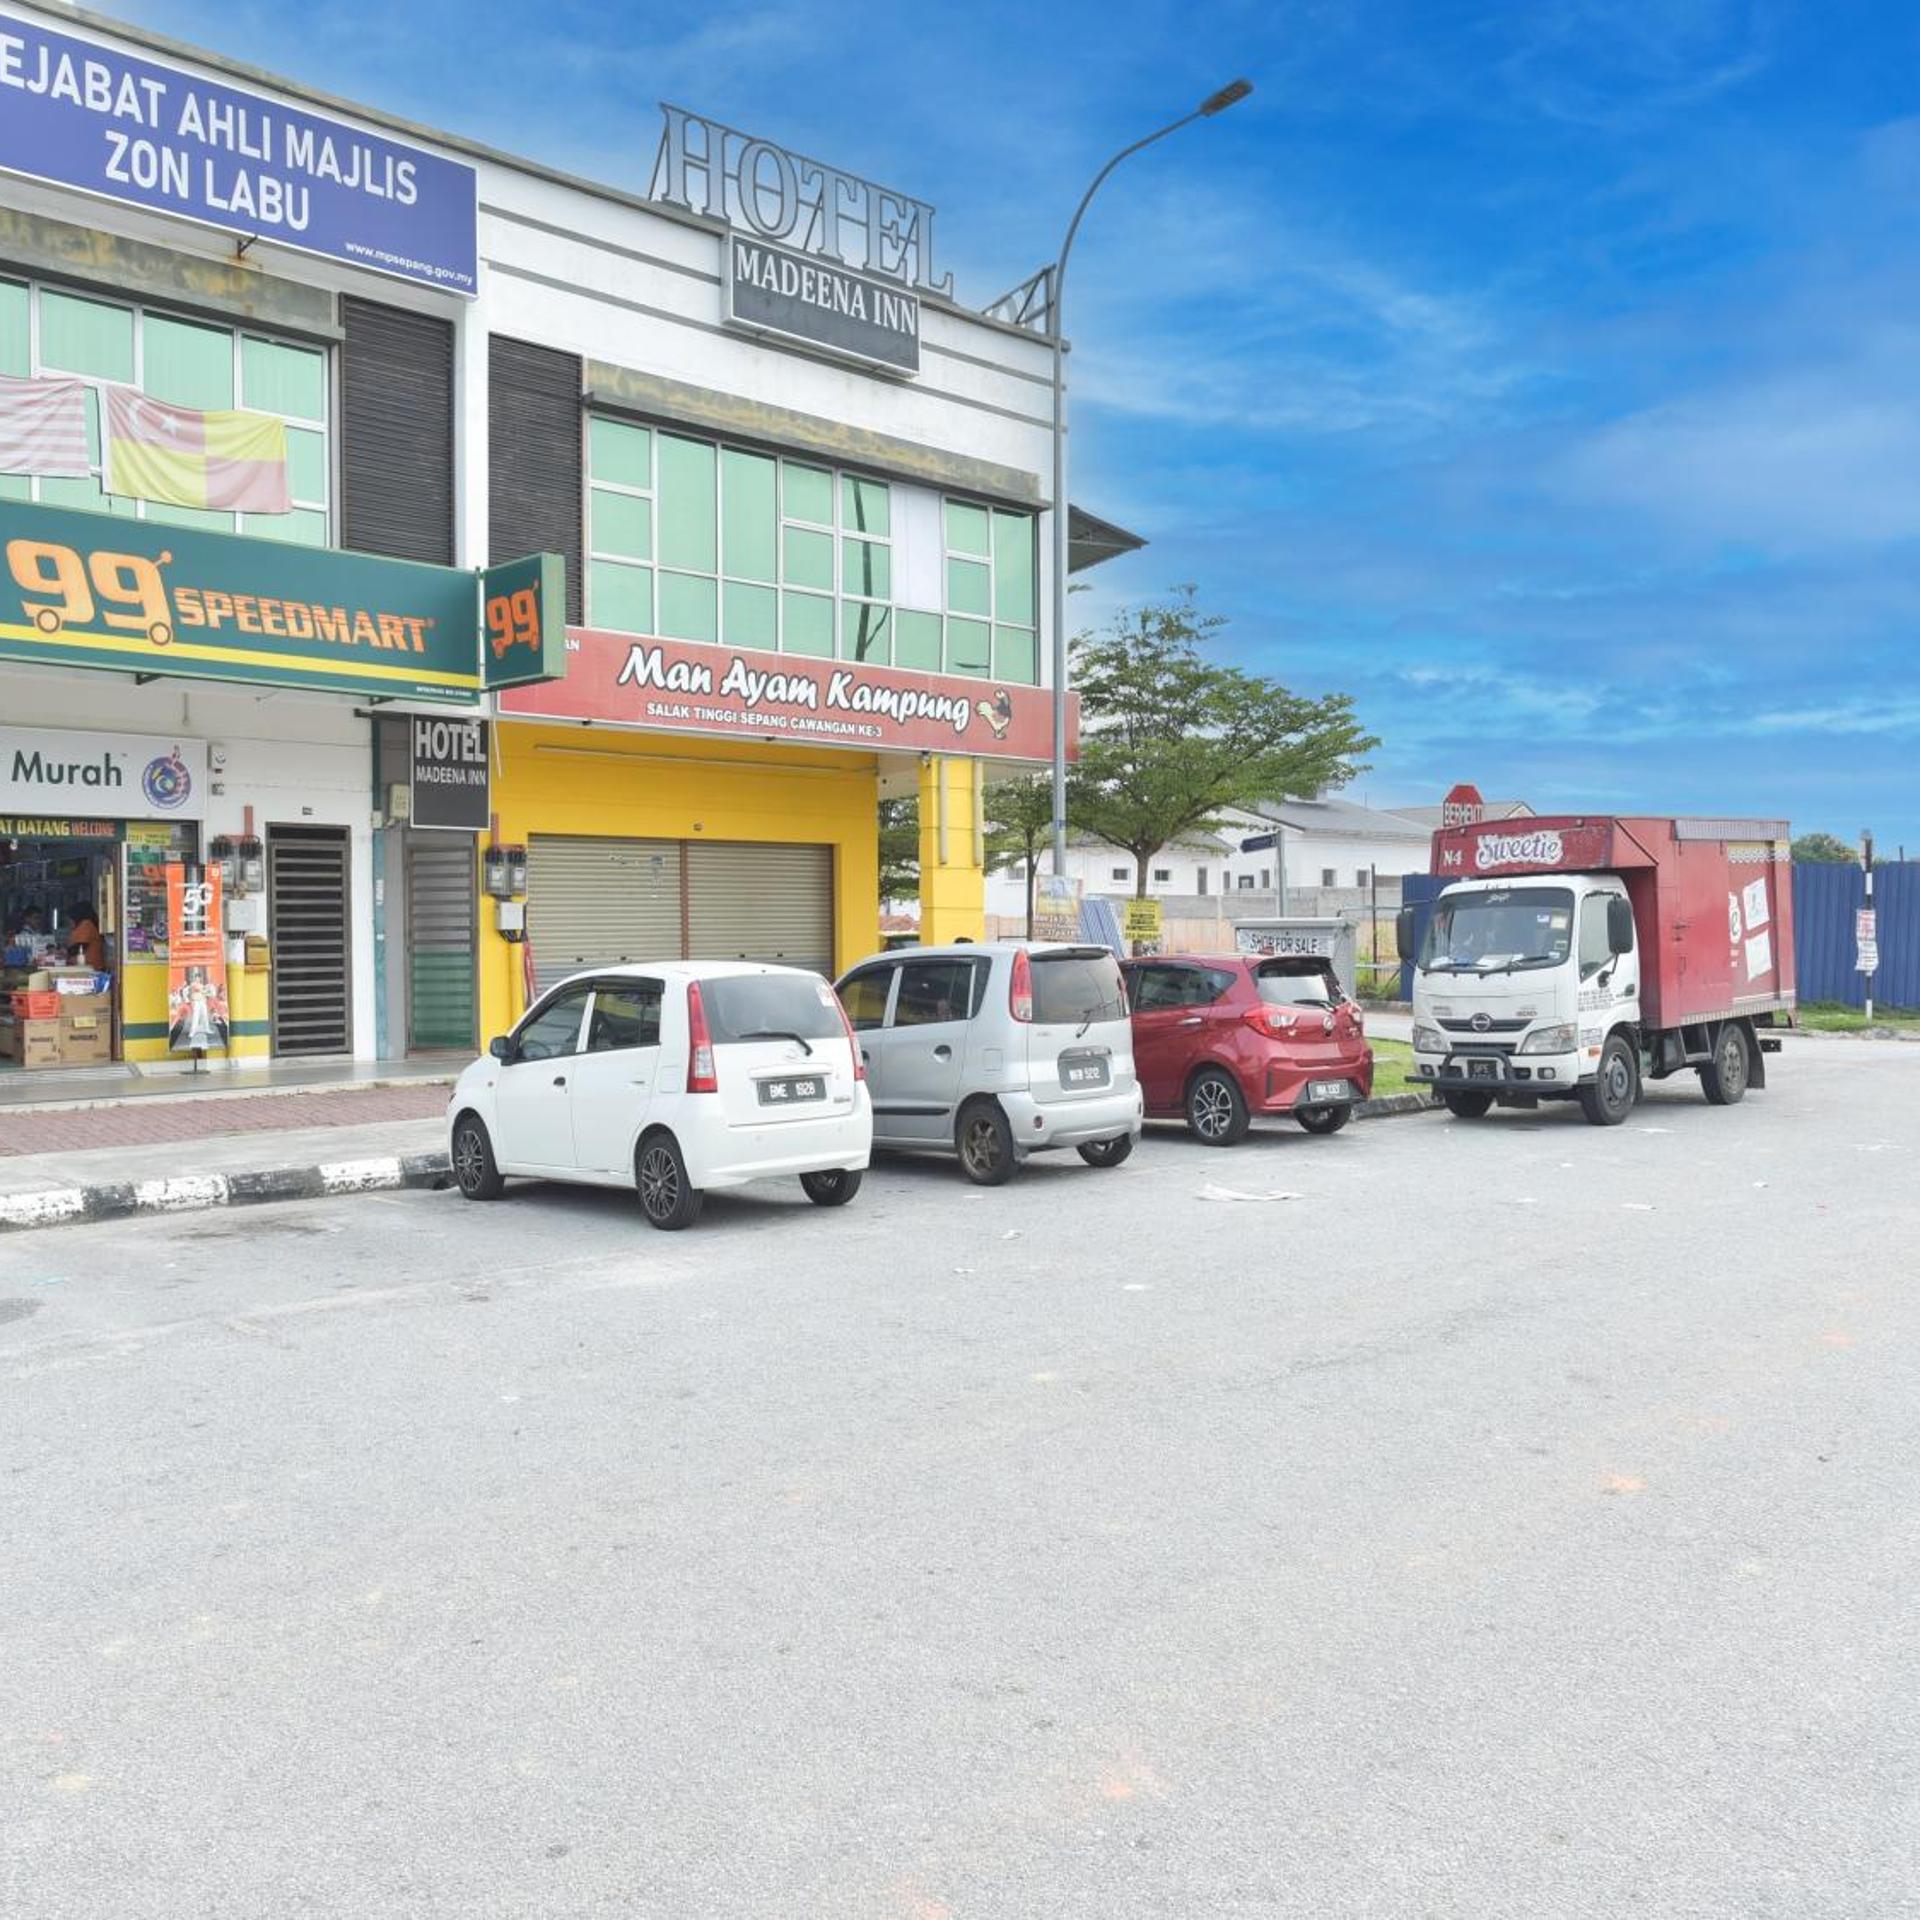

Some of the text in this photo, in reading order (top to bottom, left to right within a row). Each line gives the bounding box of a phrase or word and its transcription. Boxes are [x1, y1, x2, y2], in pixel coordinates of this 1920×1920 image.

[178, 92, 271, 162] AHLI
[286, 124, 418, 205] MAJLIS
[105, 130, 309, 231] ZON LABU
[660, 104, 953, 300] HOTEL
[736, 243, 917, 336] MADEENA INN
[6, 538, 174, 646] 99
[487, 588, 539, 659] 99
[617, 643, 971, 733] Man Ayam Kampung
[415, 720, 487, 763] HOTEL
[647, 702, 690, 719] SALAK
[693, 706, 737, 724] TINGGI
[740, 711, 787, 729] SEPANG
[790, 717, 855, 735] CAWANGAN
[11, 749, 123, 787] Murah
[416, 764, 487, 785] MADEENA INN
[1478, 832, 1560, 865] Sweetie
[182, 882, 214, 915] 5G
[1275, 936, 1295, 953] FOR
[1295, 938, 1319, 954] SALE
